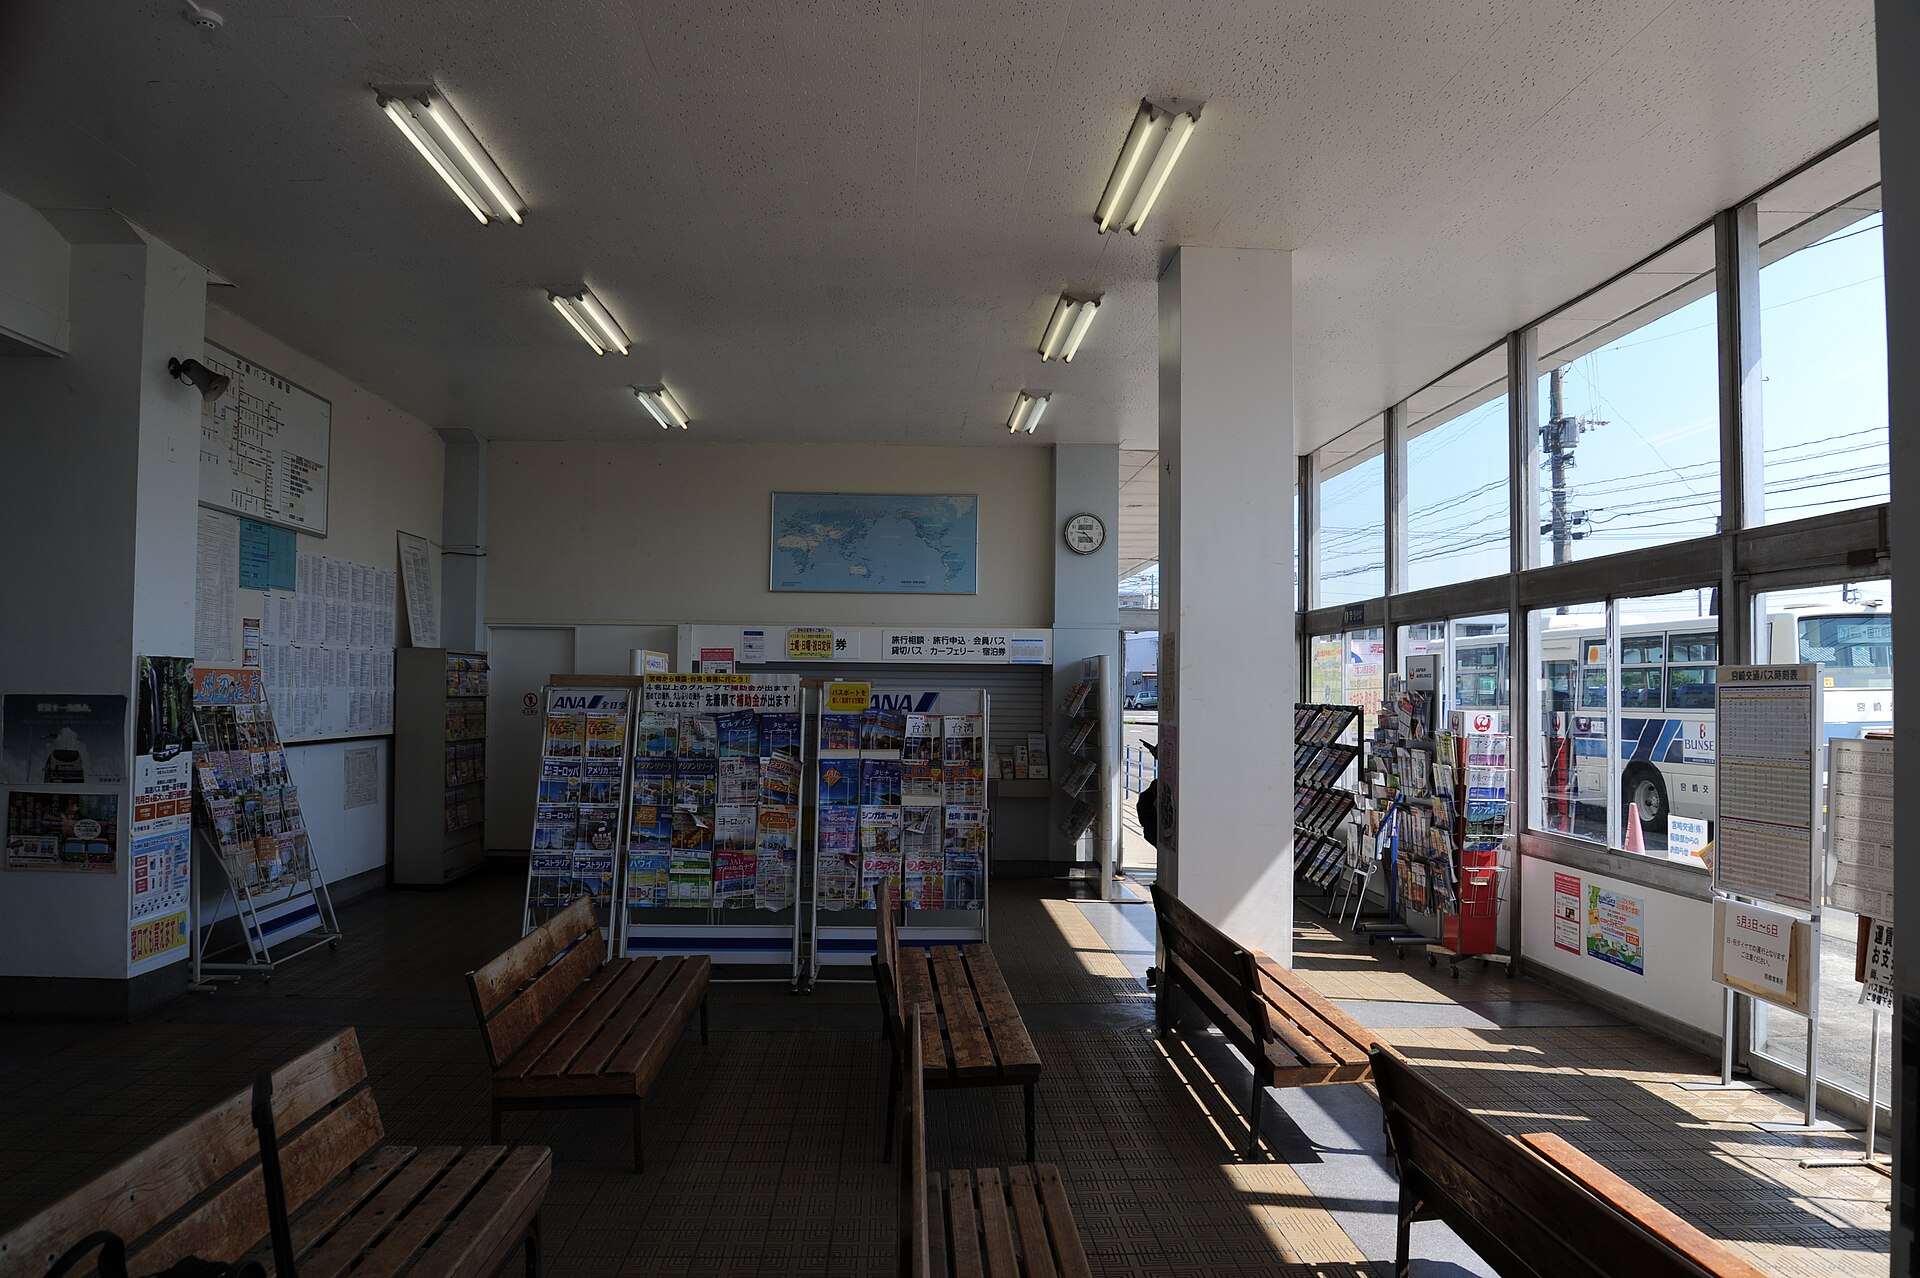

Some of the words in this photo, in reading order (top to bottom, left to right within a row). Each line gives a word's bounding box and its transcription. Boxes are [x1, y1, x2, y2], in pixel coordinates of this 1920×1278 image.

[789, 640, 832, 651] 土曜・日曜・祝日定休
[835, 638, 847, 651] 券
[1731, 670, 1798, 681] 宮崎交通バス時刻表
[553, 696, 587, 709] ANA
[601, 701, 628, 710] 全日空
[705, 693, 796, 708] 先着順で補助金が出ます！
[870, 694, 913, 712] ANA
[912, 722, 932, 733] 台湾
[951, 723, 975, 733] 台湾
[1474, 740, 1500, 748] アジア
[552, 765, 580, 777] ヨーロッパ
[586, 767, 609, 775] アメリカ
[545, 812, 575, 820] ヨーロッパ
[862, 811, 899, 820] シンガポール
[718, 817, 751, 826] ヨーロッパ
[532, 859, 571, 868] オーストラリア
[574, 861, 611, 869] オーストラリア
[629, 860, 653, 868] ハワイ
[1736, 915, 1778, 936] 5月3日〜6日
[1874, 925, 1894, 948] 運賃
[1741, 951, 1771, 967] ご注意ください。
[1872, 946, 1894, 970] お支
